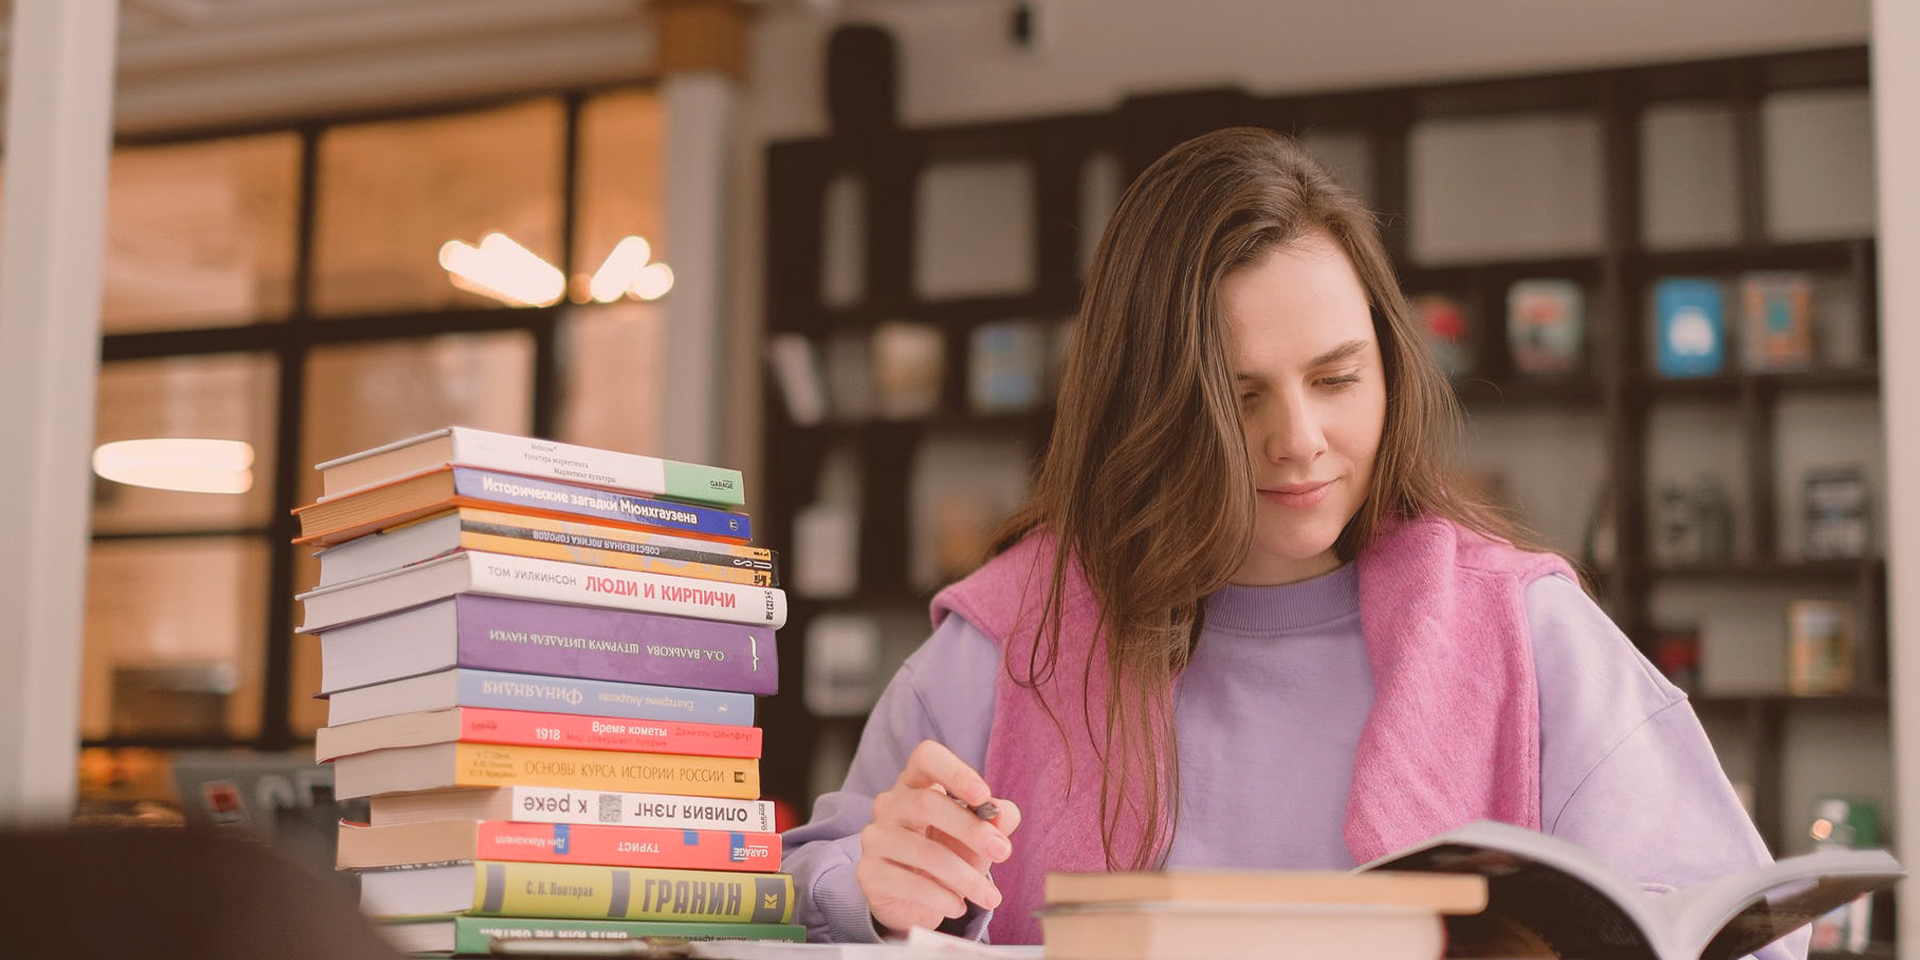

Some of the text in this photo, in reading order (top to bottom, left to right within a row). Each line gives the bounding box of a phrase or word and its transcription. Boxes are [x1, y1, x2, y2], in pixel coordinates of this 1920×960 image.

[710, 479, 734, 490] GARAGE
[483, 476, 698, 524] Исторические загадки Мюнхгаузена
[533, 530, 660, 556] СОБСТВЕННАЯ ЛОГИКА ГОРОДОВ
[488, 566, 577, 586] ТОМ УИЛКИНСОН
[585, 576, 736, 609] ЛЮДИ И КИРПИЧИ
[490, 629, 527, 643] НАУКИ
[530, 633, 586, 649] ЦИТАДЕЛЬ
[589, 639, 639, 654] ШТУРМУЯ
[647, 645, 700, 660] ВАЛЬКОВА
[535, 728, 561, 740] 1918
[592, 721, 667, 738] Время кометы
[525, 761, 575, 775] ОСНОВЫ
[581, 763, 616, 778] КУРСА
[621, 765, 674, 780] ИСТОРИИ
[680, 768, 725, 783] РОССИИ
[524, 793, 570, 813] реке
[548, 836, 566, 849] Дин
[617, 841, 660, 853] ТУРИСТ
[733, 846, 768, 859] GARAGE
[642, 879, 742, 916] ГРАНИН
